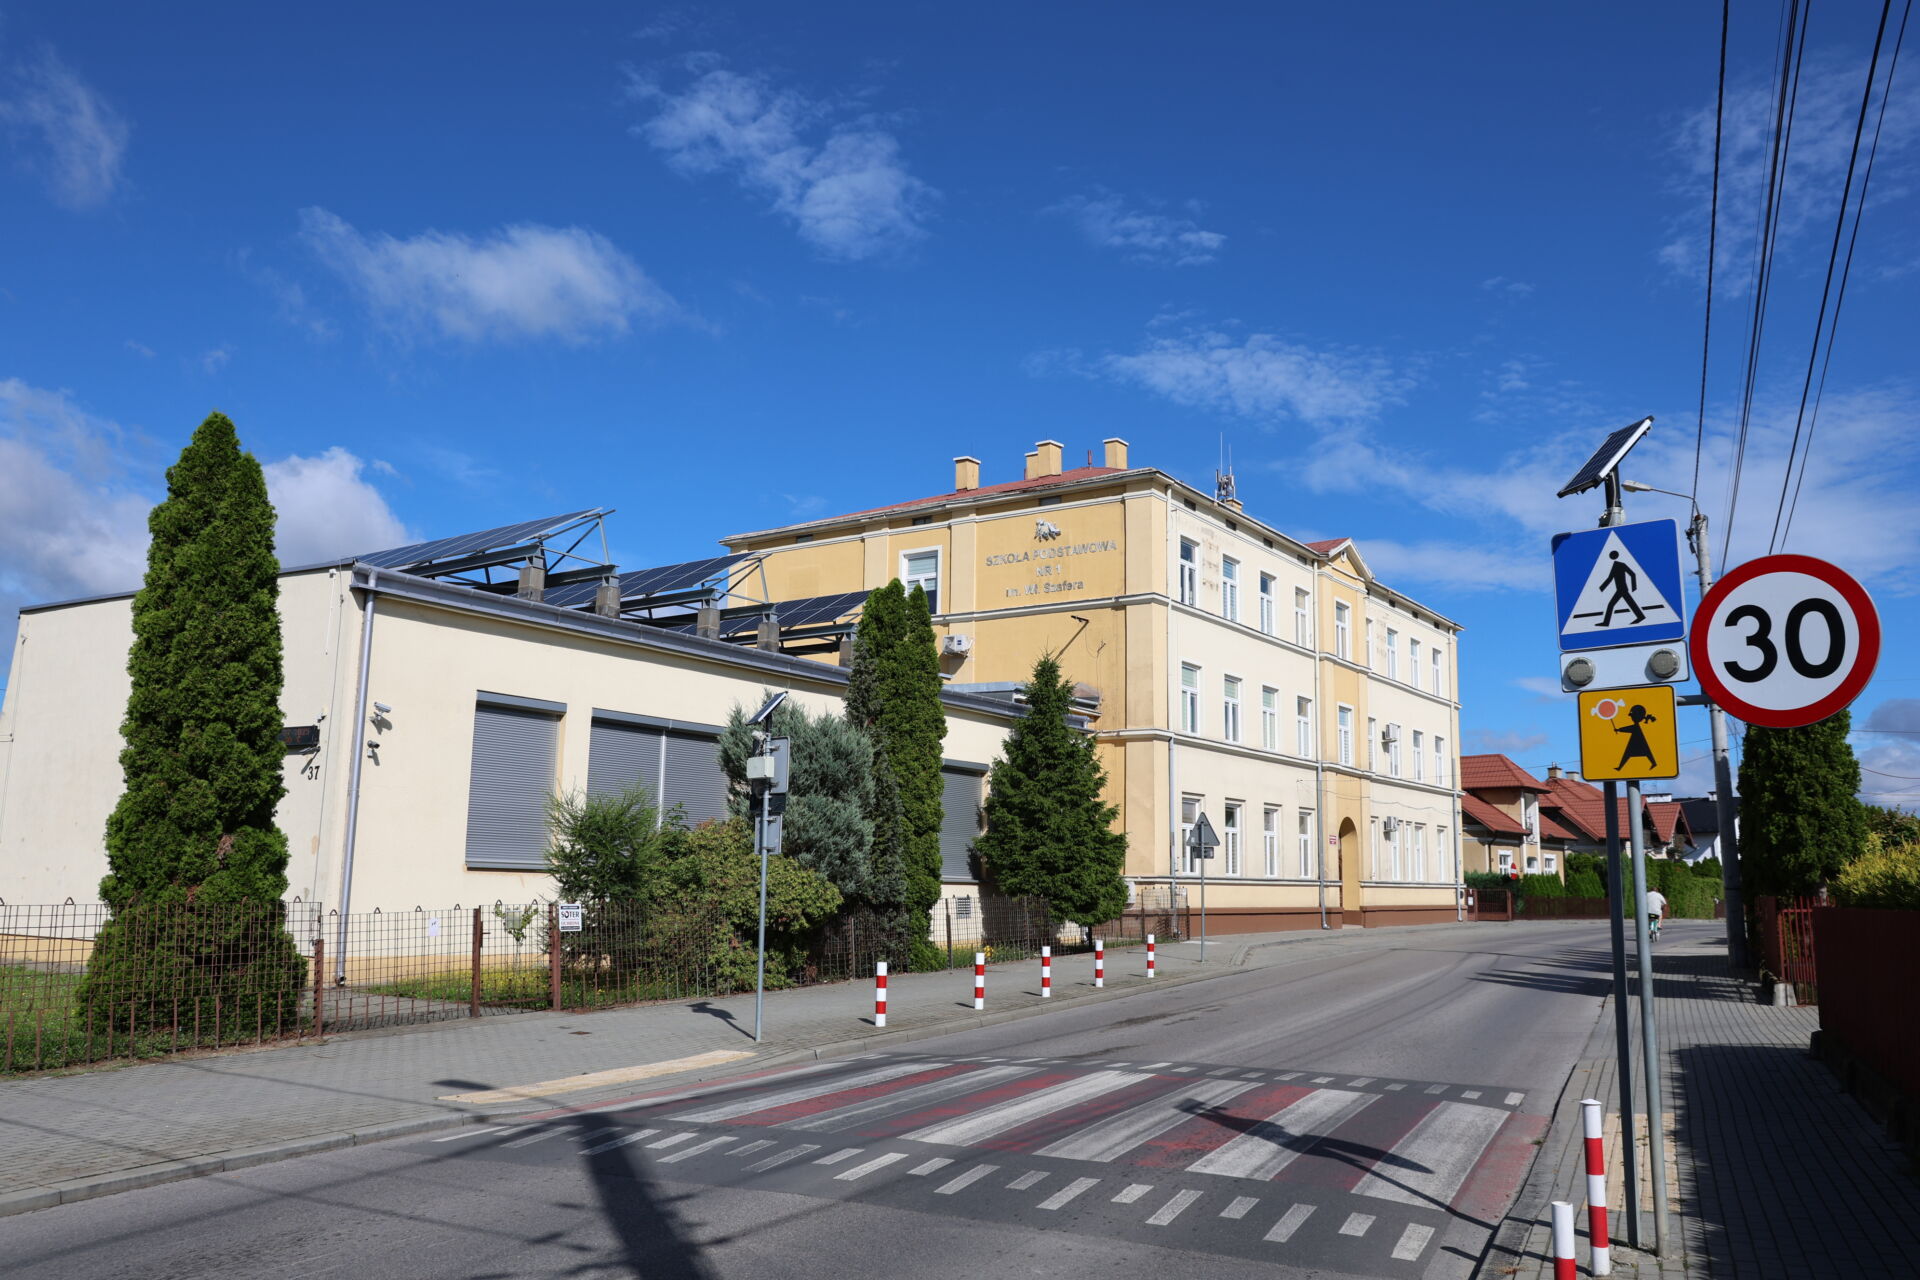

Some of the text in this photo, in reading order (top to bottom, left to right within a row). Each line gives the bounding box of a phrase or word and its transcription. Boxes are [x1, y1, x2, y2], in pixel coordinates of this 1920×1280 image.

[1033, 540, 1117, 560] PODSTAWOWA
[1036, 564, 1062, 577] NR 1
[1044, 580, 1084, 594] Szafera
[1723, 597, 1846, 683] 30
[307, 766, 320, 780] 37
